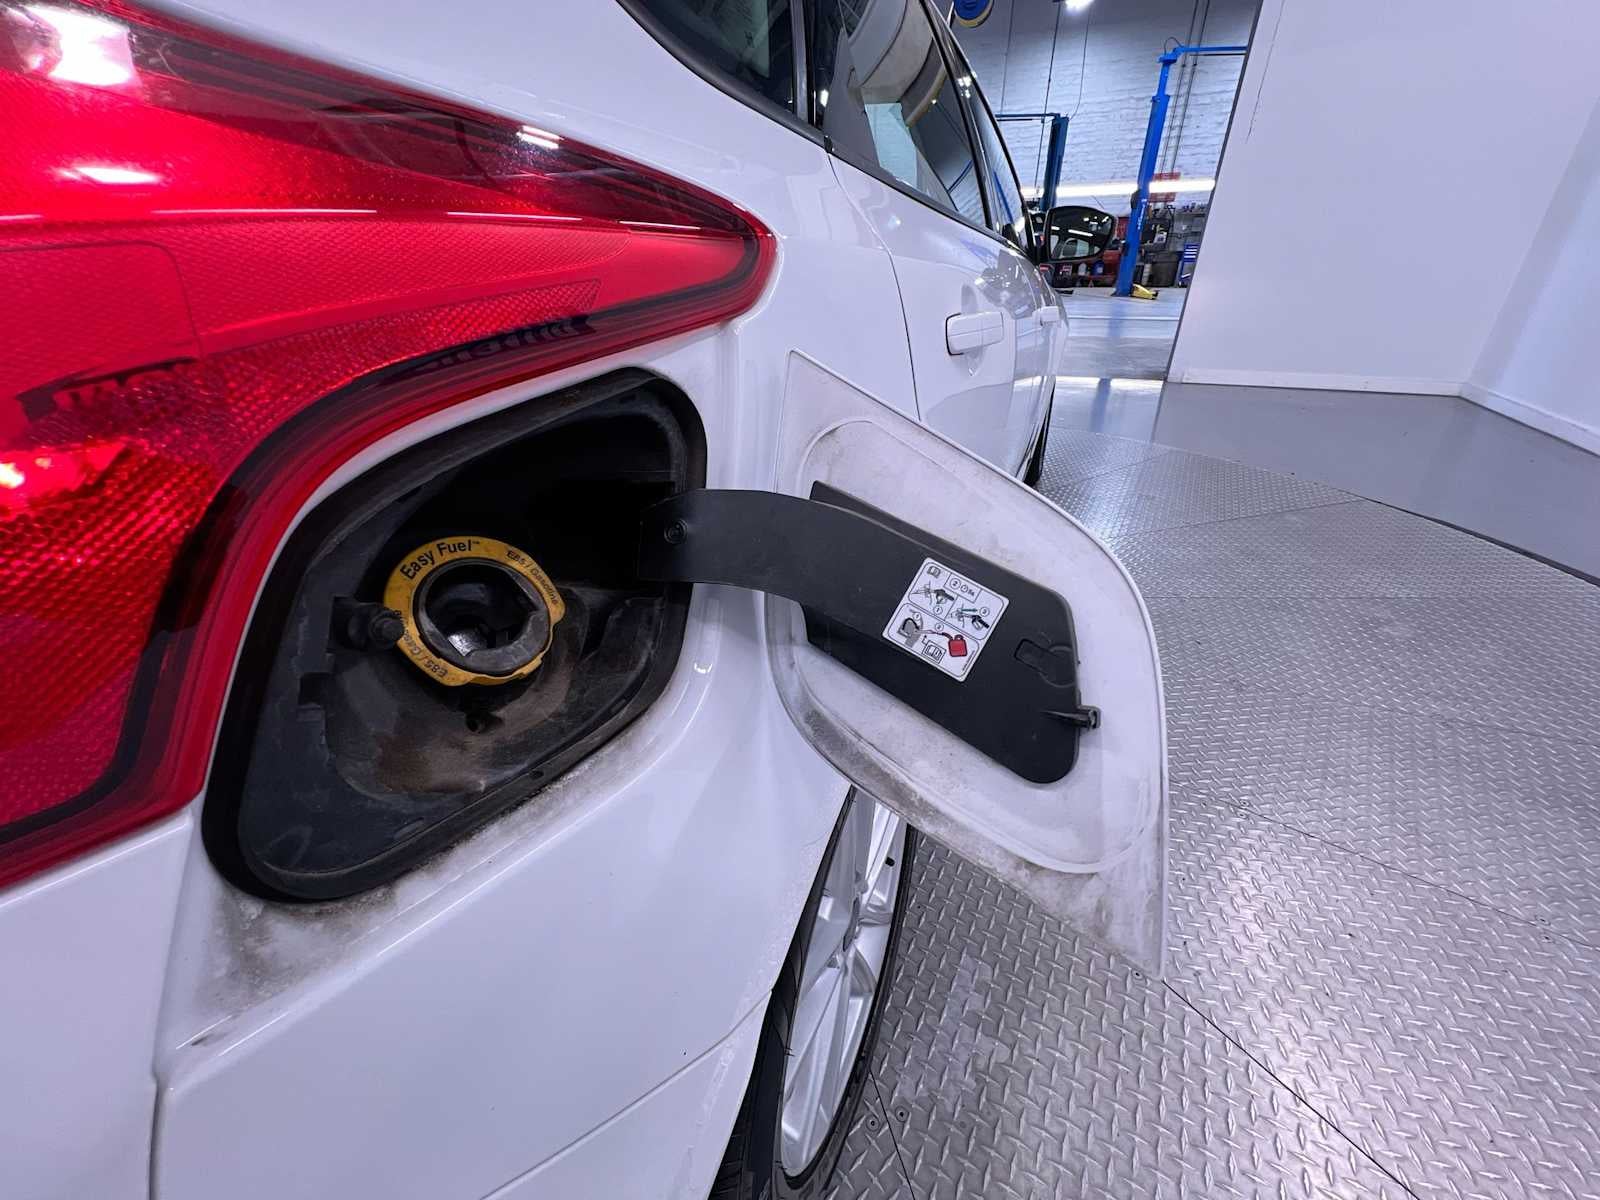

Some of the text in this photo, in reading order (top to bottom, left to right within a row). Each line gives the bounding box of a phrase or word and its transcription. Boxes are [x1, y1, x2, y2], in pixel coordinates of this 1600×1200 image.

[400, 551, 434, 580] Easy
[531, 569, 558, 605] Gasoline
[424, 660, 448, 677] E85
